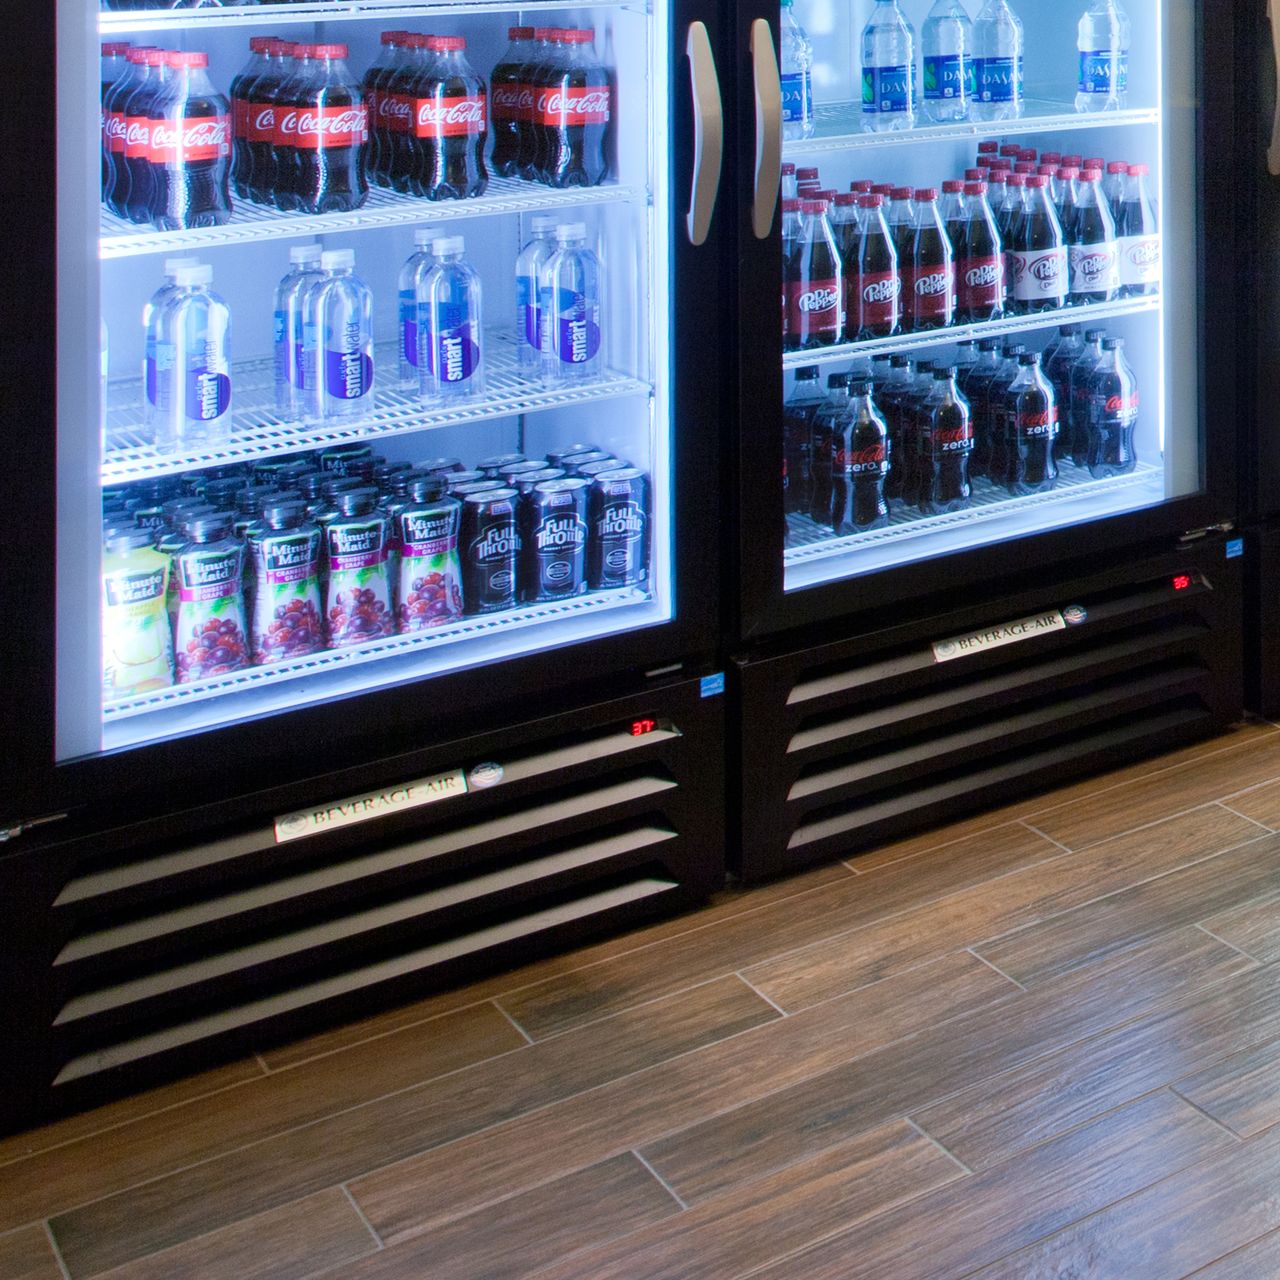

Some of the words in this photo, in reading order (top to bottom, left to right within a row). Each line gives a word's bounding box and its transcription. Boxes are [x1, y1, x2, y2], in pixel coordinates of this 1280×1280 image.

[418, 101, 486, 125] Coca-Cola
[548, 90, 610, 114] Coca-Cola
[298, 109, 367, 134] Coca-Cola
[152, 122, 226, 149] Coca-Cola
[958, 614, 1057, 650] BEVERAGE-AIR
[312, 776, 457, 825] BEVERAGE-AIR
